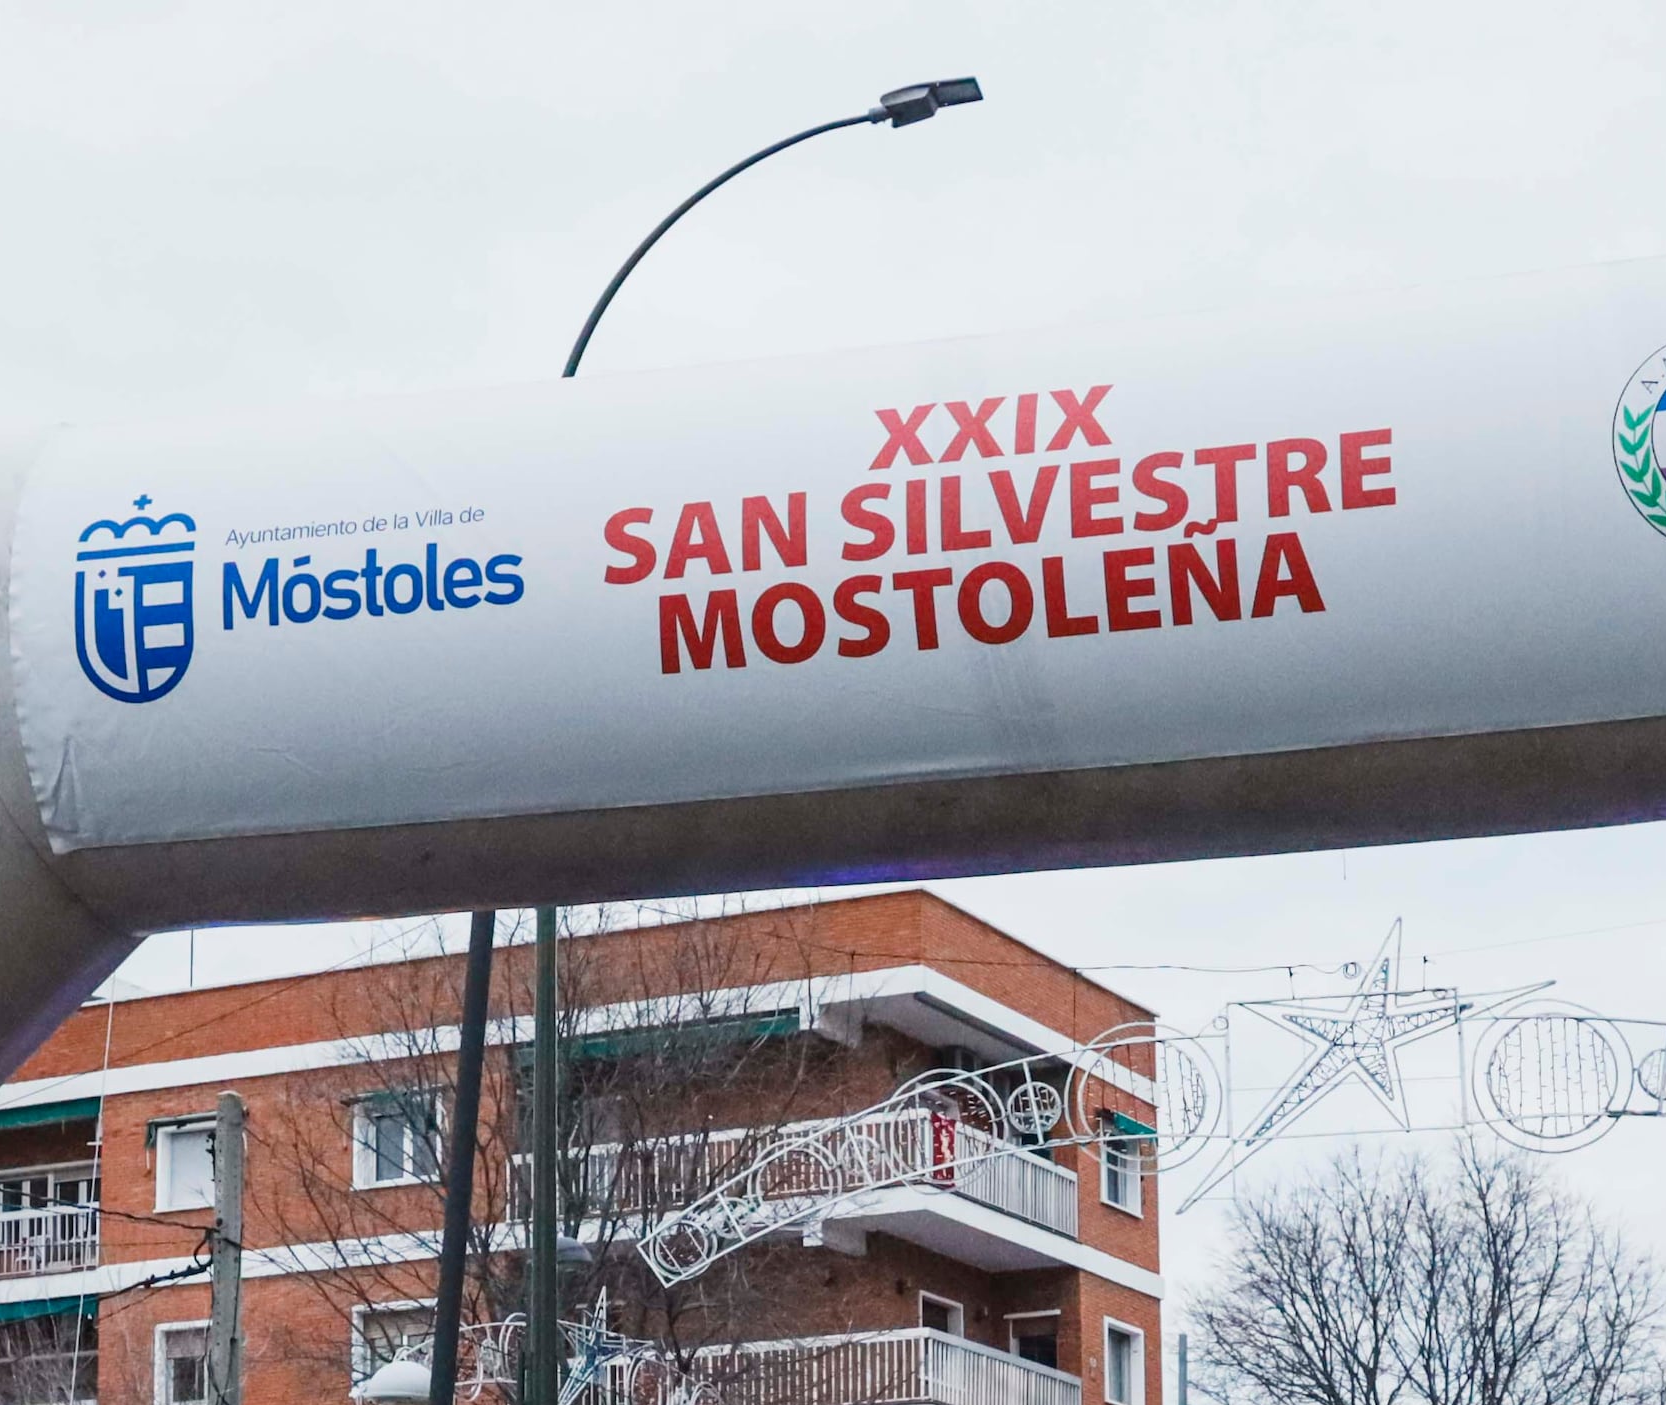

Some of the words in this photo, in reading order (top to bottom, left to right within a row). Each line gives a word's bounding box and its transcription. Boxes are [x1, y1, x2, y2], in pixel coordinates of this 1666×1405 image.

[869, 385, 1114, 471] XXIX
[225, 518, 358, 549] Ayuntamiento
[362, 515, 388, 533] de
[393, 513, 410, 531] la
[415, 509, 454, 528] Villa
[459, 506, 486, 524] de
[603, 491, 808, 586] SAN
[840, 427, 1397, 564] SILVESTRE
[222, 543, 525, 631] Móstoles
[658, 520, 1327, 675] MOSTOLEÑA
